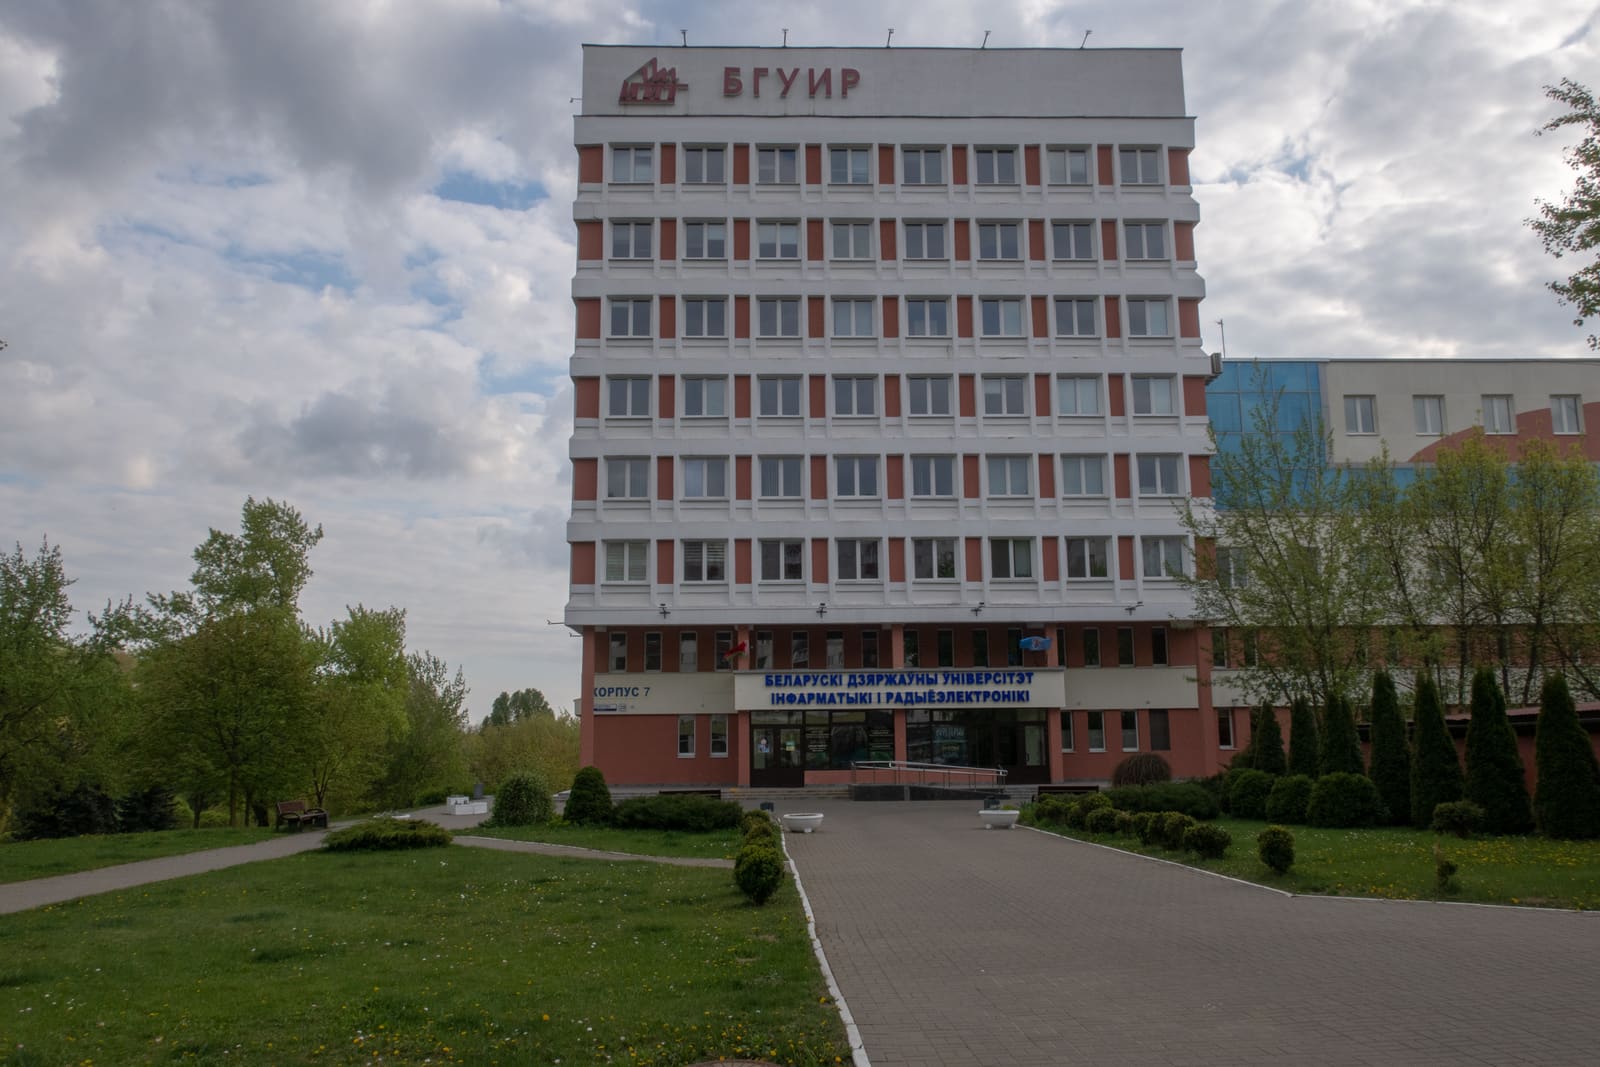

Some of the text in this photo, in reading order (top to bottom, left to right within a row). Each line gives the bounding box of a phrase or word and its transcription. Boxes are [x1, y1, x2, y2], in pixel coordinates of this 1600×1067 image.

[723, 67, 861, 98] БГУИР
[765, 674, 842, 687] БЕЛАРУСКІ
[644, 687, 651, 697] 7
[771, 692, 872, 705] ІНФАРМАТЫКІ
[886, 689, 1030, 706] РАДЫЁЭЛЕКТРОНІКІ
